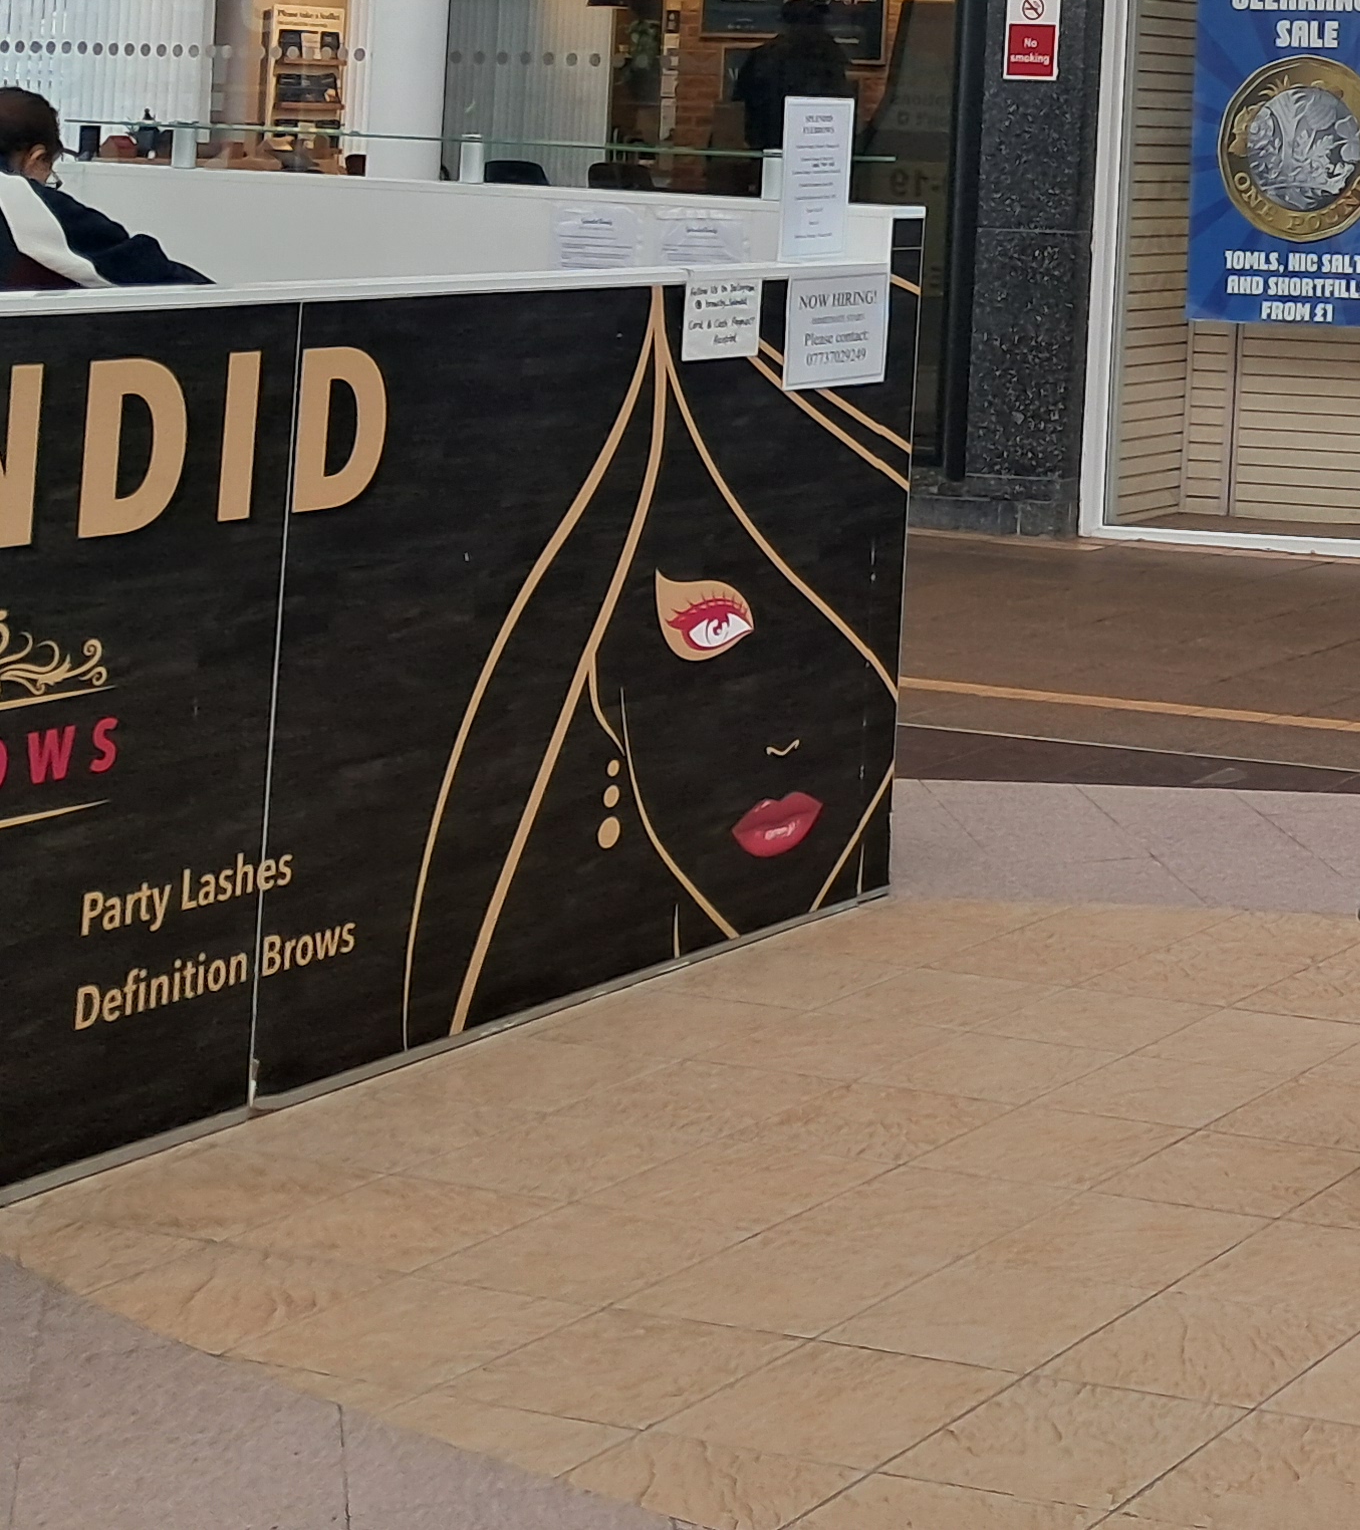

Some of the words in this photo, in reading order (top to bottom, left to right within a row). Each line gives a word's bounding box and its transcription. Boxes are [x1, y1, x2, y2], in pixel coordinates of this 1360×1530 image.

[1023, 37, 1038, 48] No
[1275, 19, 1340, 49] SALE
[1010, 52, 1050, 66] smoking
[1233, 172, 1275, 221] ONE
[1224, 250, 1285, 273] 10MLS,
[1287, 252, 1319, 272] NIC
[1226, 276, 1264, 296] AND
[799, 294, 831, 311] NOW
[832, 290, 878, 308] HIRING!
[1260, 301, 1310, 322] FROM
[1313, 302, 1334, 323] £1
[804, 333, 834, 347] Please
[0, 716, 119, 789] WS
[80, 881, 173, 938] Party
[181, 852, 294, 911] Lashes
[73, 951, 248, 1031] Definition
[260, 921, 357, 977] Brows
